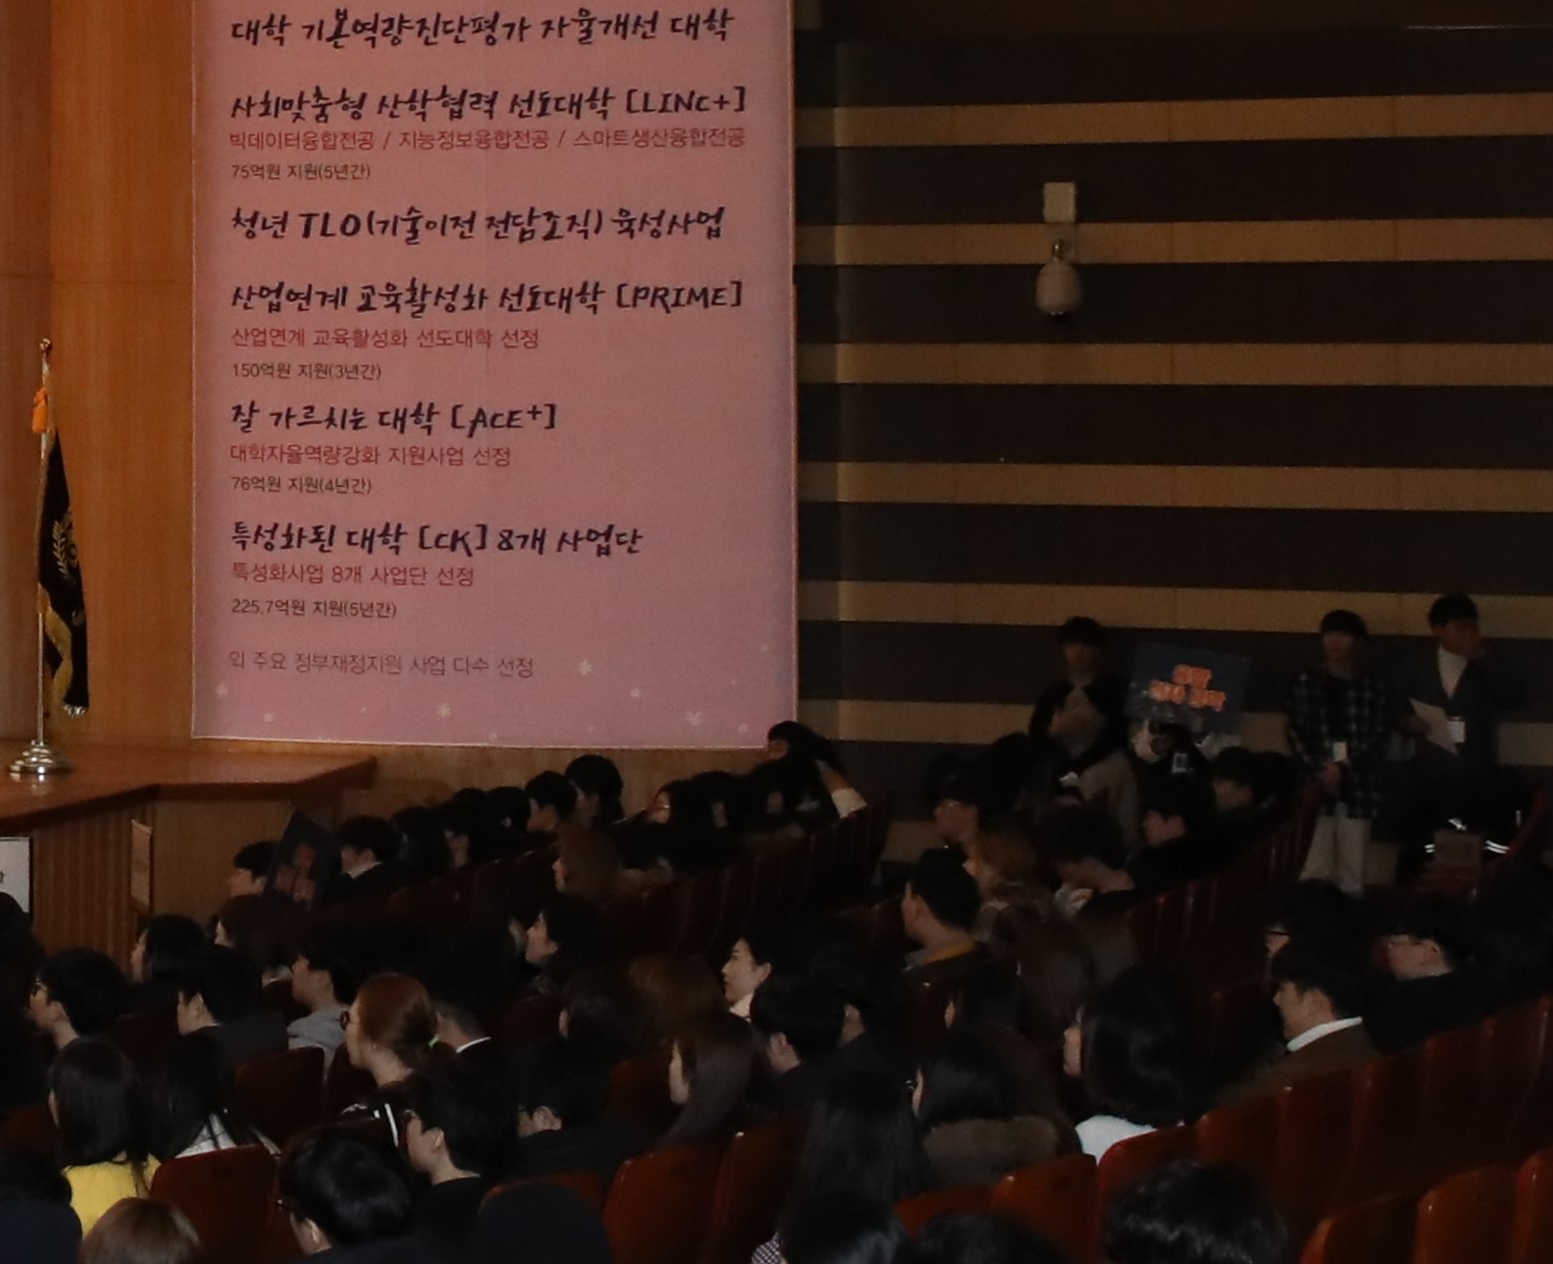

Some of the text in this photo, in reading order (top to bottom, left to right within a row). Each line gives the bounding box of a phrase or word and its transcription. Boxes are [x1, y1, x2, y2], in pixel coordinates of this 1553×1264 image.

[231, 6, 735, 50] 대학 기본역량진단평가 자율개선 대학
[230, 84, 368, 124] 사회맞춤형
[376, 84, 499, 123] 산학협력
[508, 86, 616, 121] 선도대학
[229, 130, 375, 152] 빅데이터융합전공
[398, 129, 550, 152] 지능정보융합전공
[572, 126, 746, 150] 스마트생산융합전공
[231, 162, 372, 181] 75억원 지원(5년간)
[231, 206, 289, 240] 청년
[485, 205, 603, 244] 전담조직)
[610, 206, 726, 241] 육성사업
[231, 281, 349, 315] 산업연계
[355, 276, 489, 319] 교육활성화
[498, 280, 606, 315] 선도대학
[231, 327, 539, 350] 산업연계 교육활성화 선도대학 선정
[232, 362, 383, 382] 150억원 지원(3년간)
[231, 399, 261, 434] 잘
[269, 404, 368, 431] 가르치는
[377, 401, 441, 437] 대학
[229, 443, 512, 468] 대학자율역량강화 지원사업 선정
[231, 475, 373, 495] 76억원 지원(4년간)
[231, 521, 337, 554] 특성화된
[345, 521, 408, 556] 대학
[496, 527, 547, 556] 8개
[555, 523, 644, 558] 사업단
[232, 561, 475, 588] 특성화사업 8개 사업단 선정
[231, 598, 398, 620] 225.7억원 지원(5년간)
[228, 650, 534, 680] 외 주요 정부재정지원 사업 다수 선정
